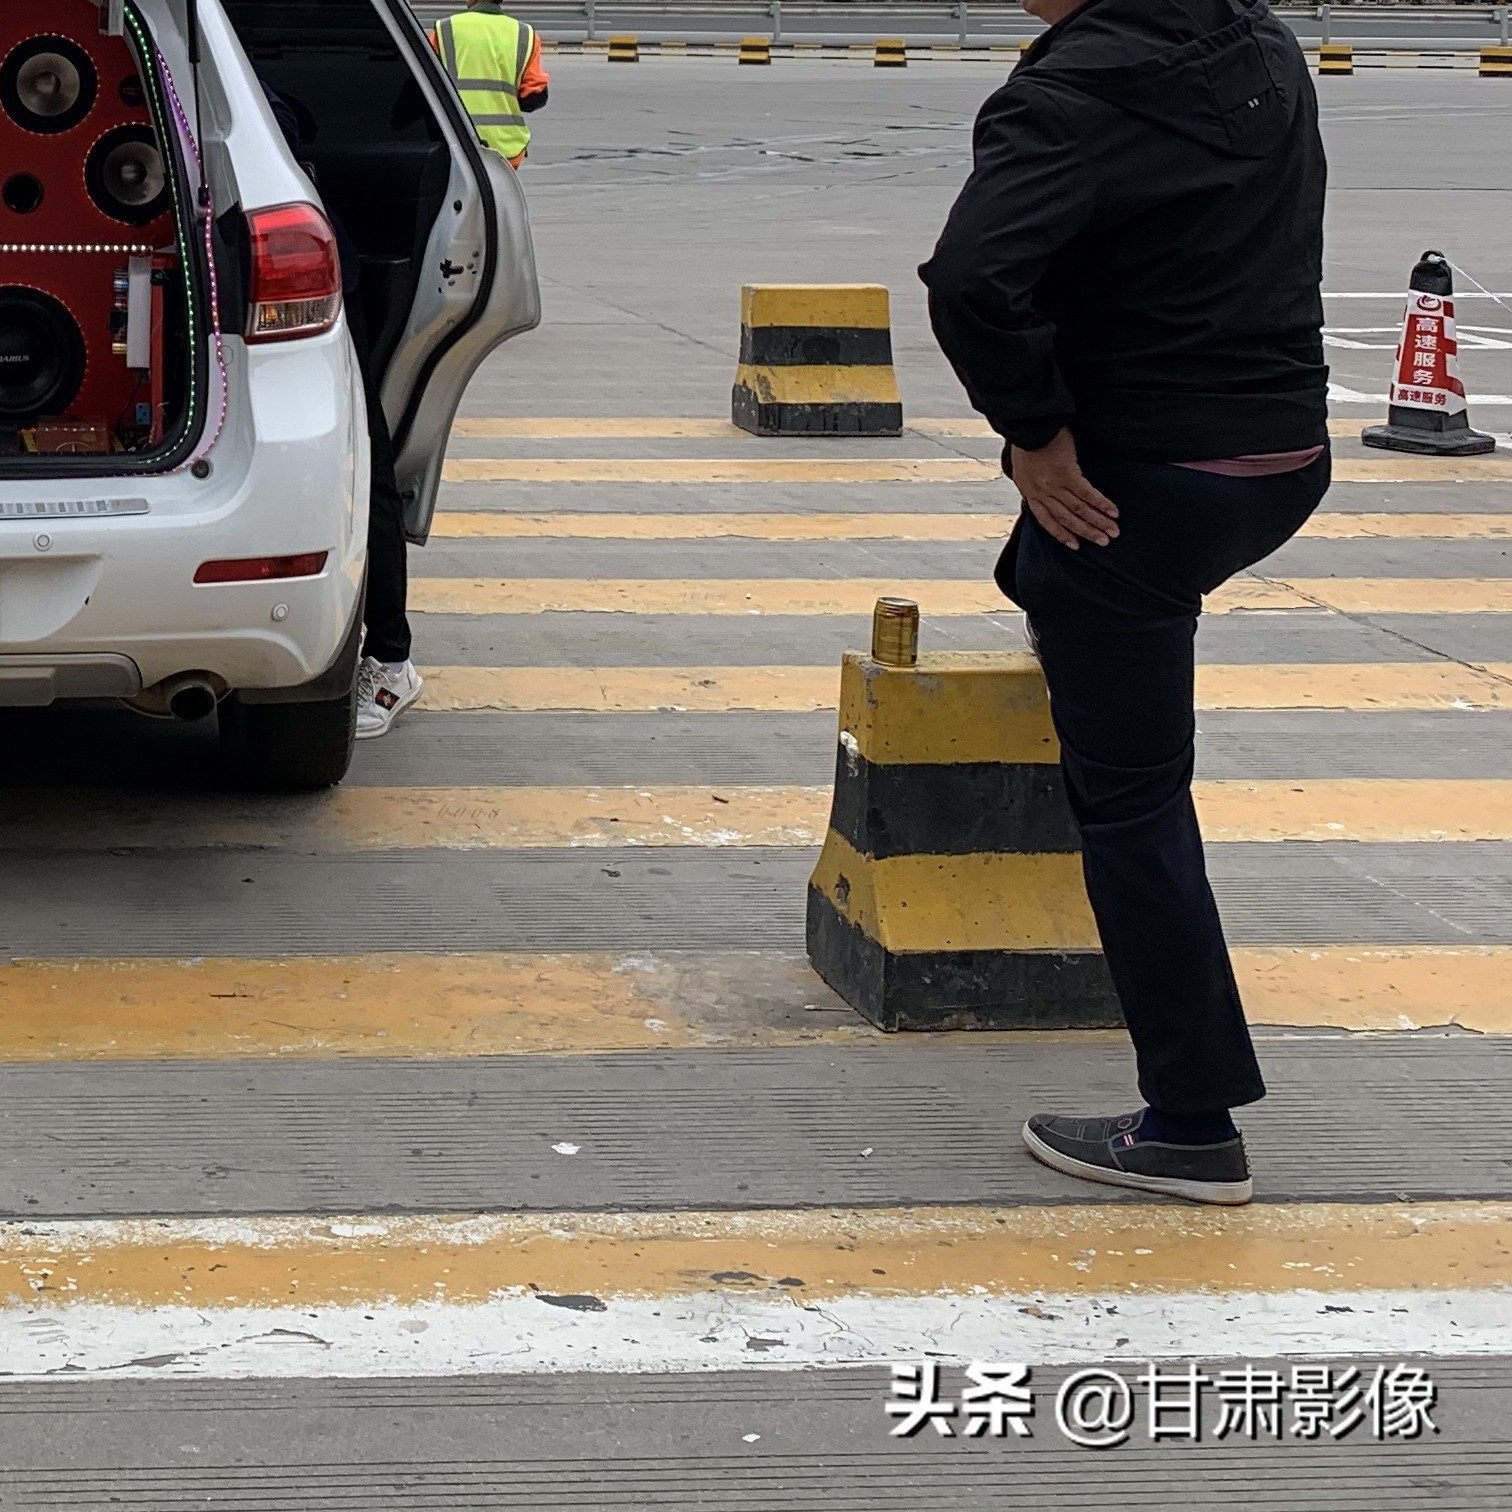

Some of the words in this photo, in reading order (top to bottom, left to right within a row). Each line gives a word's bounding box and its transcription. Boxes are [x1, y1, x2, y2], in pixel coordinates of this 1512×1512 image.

[1413, 316, 1439, 386] 高速服务
[1397, 390, 1447, 406] 高速服务
